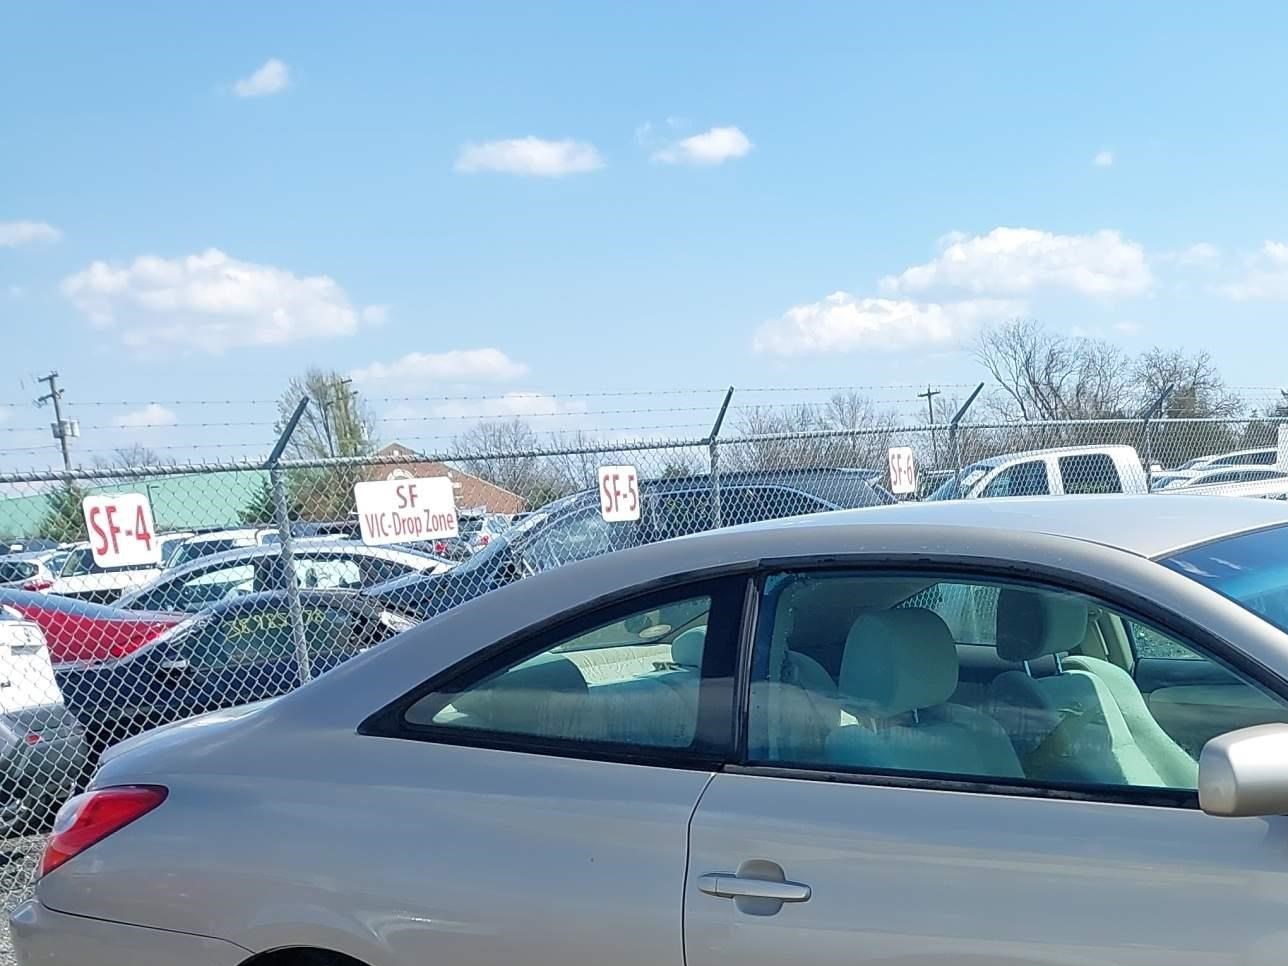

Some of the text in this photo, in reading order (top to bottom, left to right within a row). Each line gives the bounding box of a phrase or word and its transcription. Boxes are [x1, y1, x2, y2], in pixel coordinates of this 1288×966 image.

[891, 453, 913, 486] SF-6
[396, 484, 418, 509] SF
[603, 474, 637, 513] SF-5
[89, 505, 151, 556] SF-4
[365, 509, 454, 539] VIC-Drop Zone
